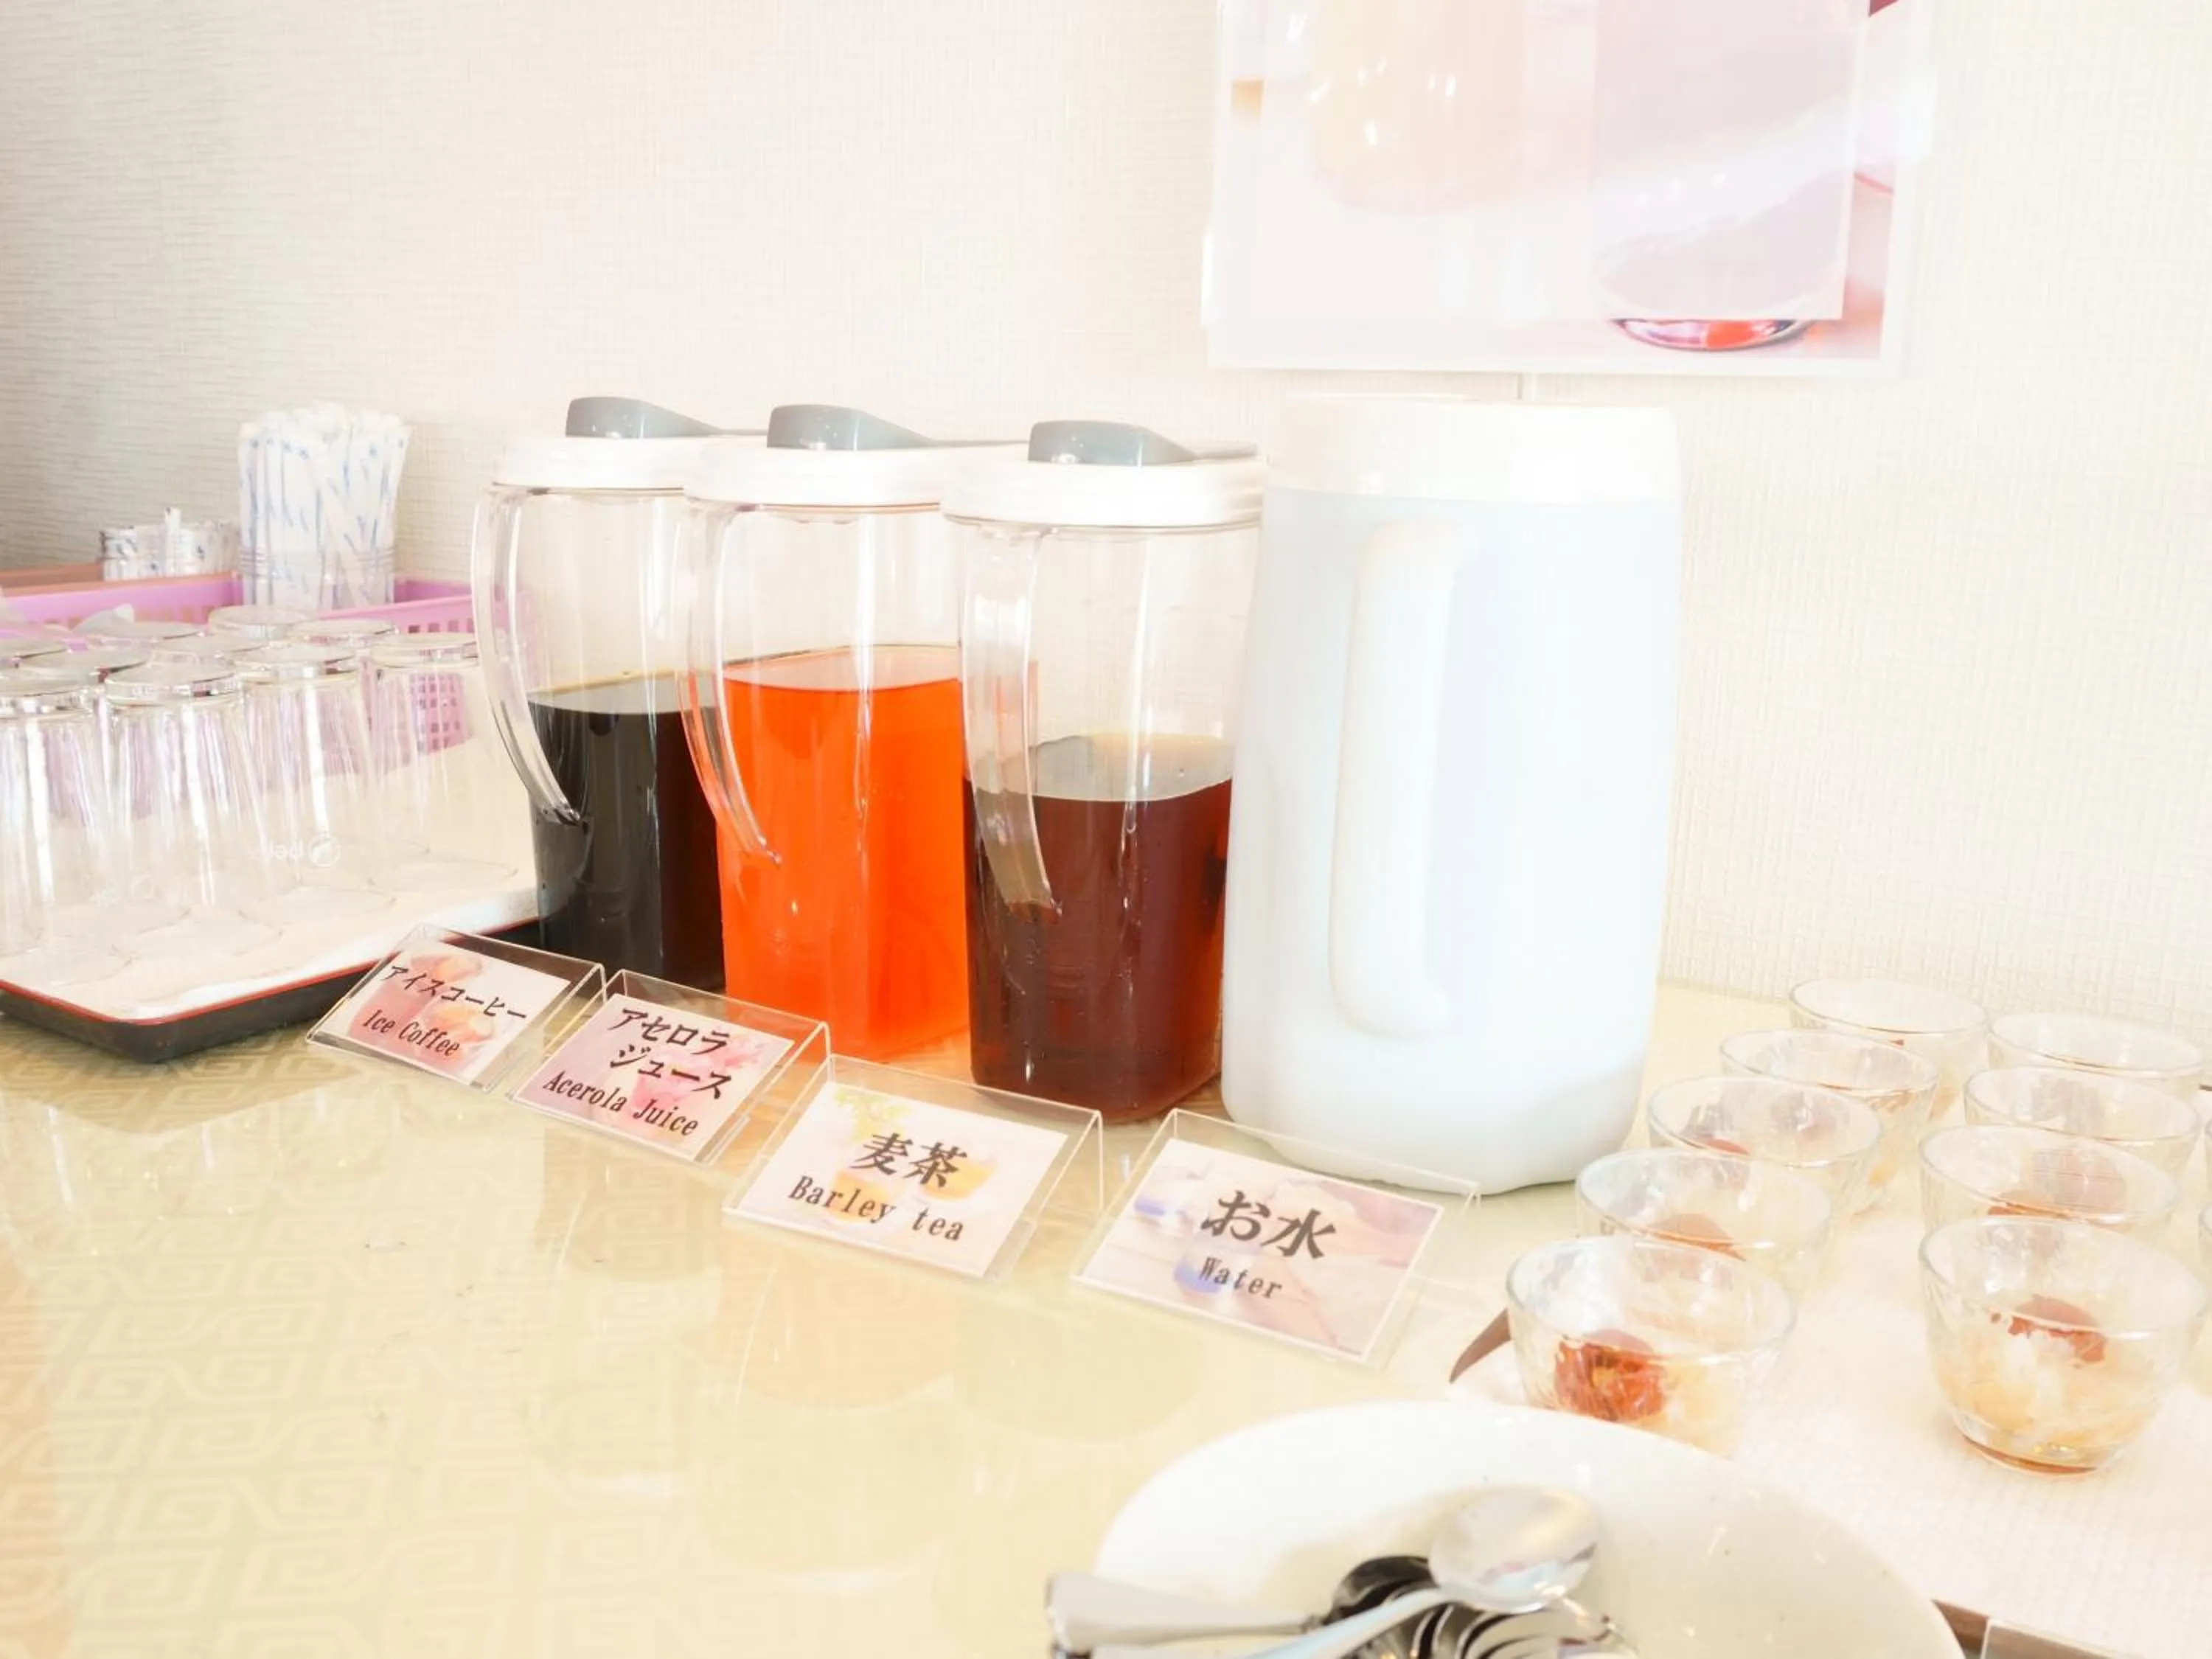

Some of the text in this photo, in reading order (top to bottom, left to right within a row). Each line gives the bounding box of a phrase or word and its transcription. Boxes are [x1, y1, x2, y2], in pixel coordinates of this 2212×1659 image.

[382, 965, 527, 1018] アイスコーヒー
[364, 1009, 461, 1057] Ice Coffee
[608, 1008, 730, 1055] アセロラ
[610, 1044, 731, 1099] ジュース
[543, 1070, 699, 1136] Acerola Juice
[850, 1133, 967, 1189] 麦茶
[788, 1175, 964, 1242] Barley tea
[1200, 1189, 1336, 1259] お水
[1200, 1256, 1283, 1298] Water
